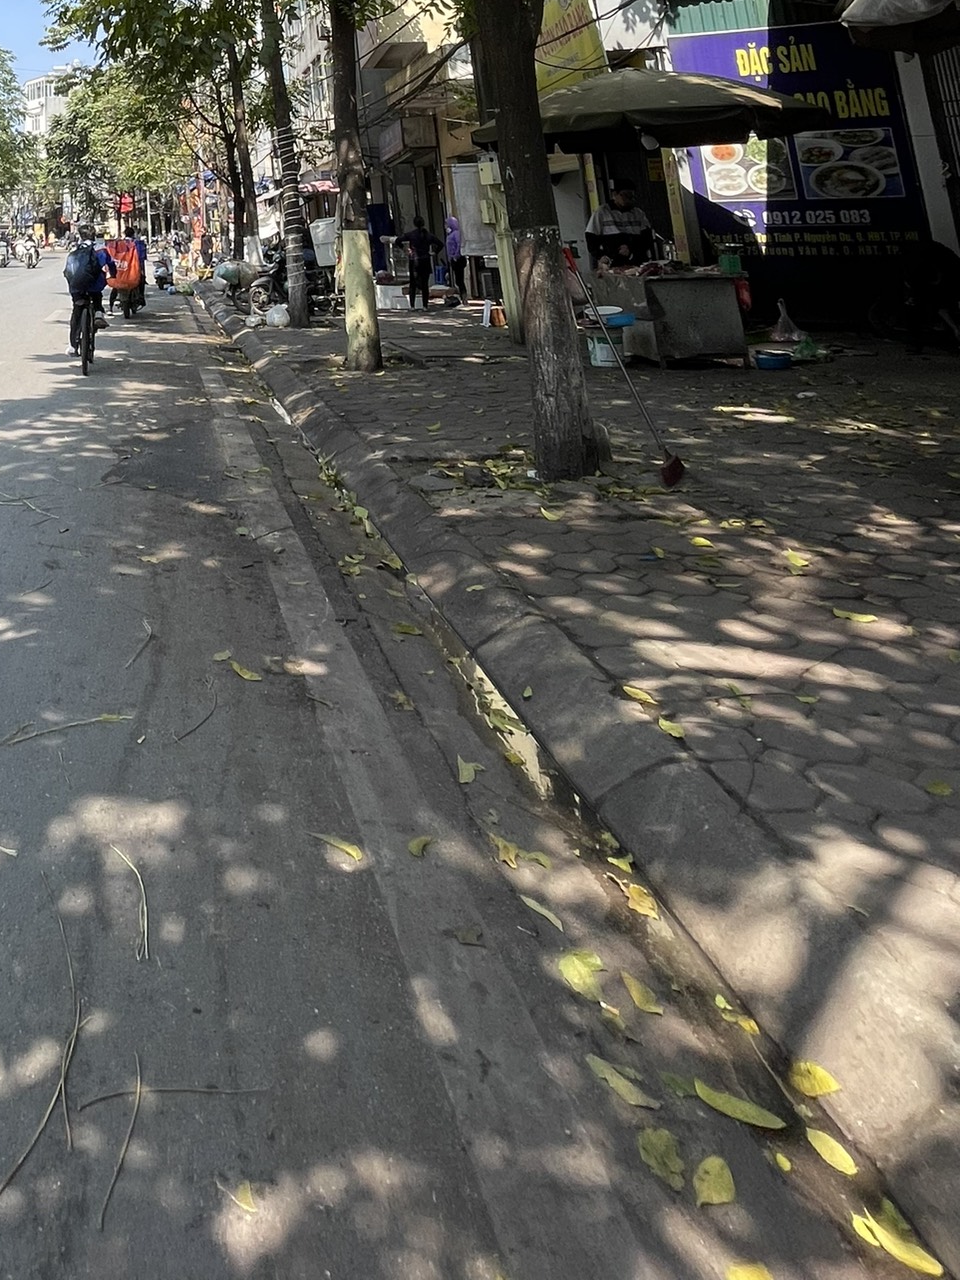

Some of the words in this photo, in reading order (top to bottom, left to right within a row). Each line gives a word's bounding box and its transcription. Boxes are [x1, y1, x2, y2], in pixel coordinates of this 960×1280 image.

[735, 41, 774, 82] ĐẶC
[776, 35, 817, 74] SẢN
[762, 210, 803, 225] 0912
[805, 209, 836, 224] 025
[841, 209, 871, 224] 083
